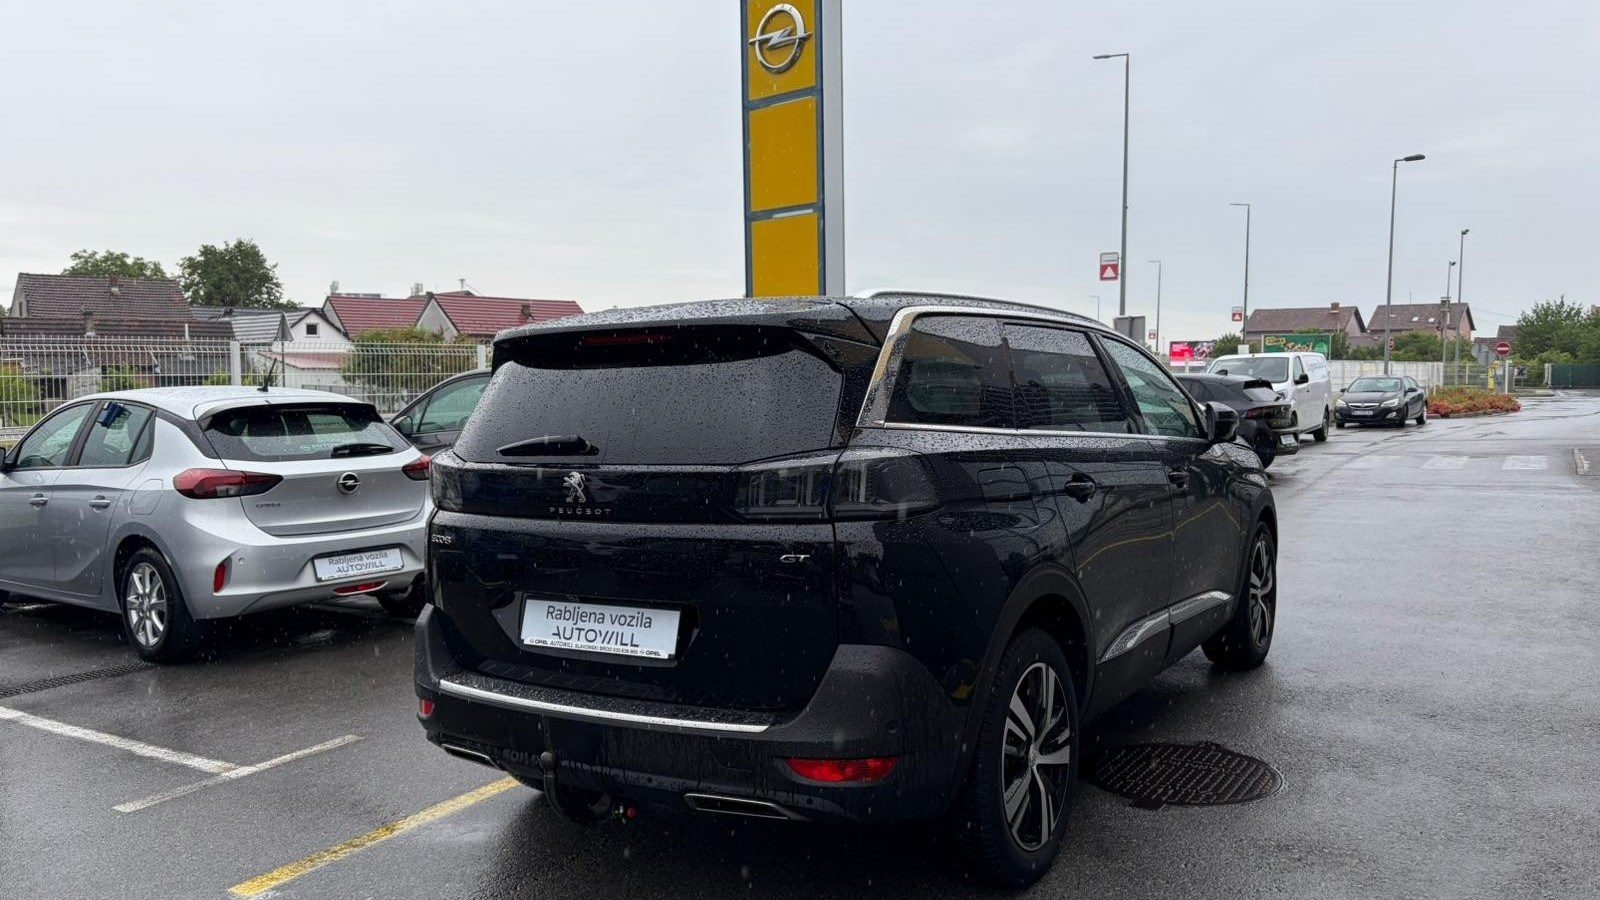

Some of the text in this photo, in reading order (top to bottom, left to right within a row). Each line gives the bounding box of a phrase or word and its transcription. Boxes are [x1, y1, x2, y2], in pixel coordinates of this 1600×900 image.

[549, 506, 612, 516] PEUGEOT
[779, 554, 811, 563] GT
[545, 604, 653, 629] Rabljena vozila
